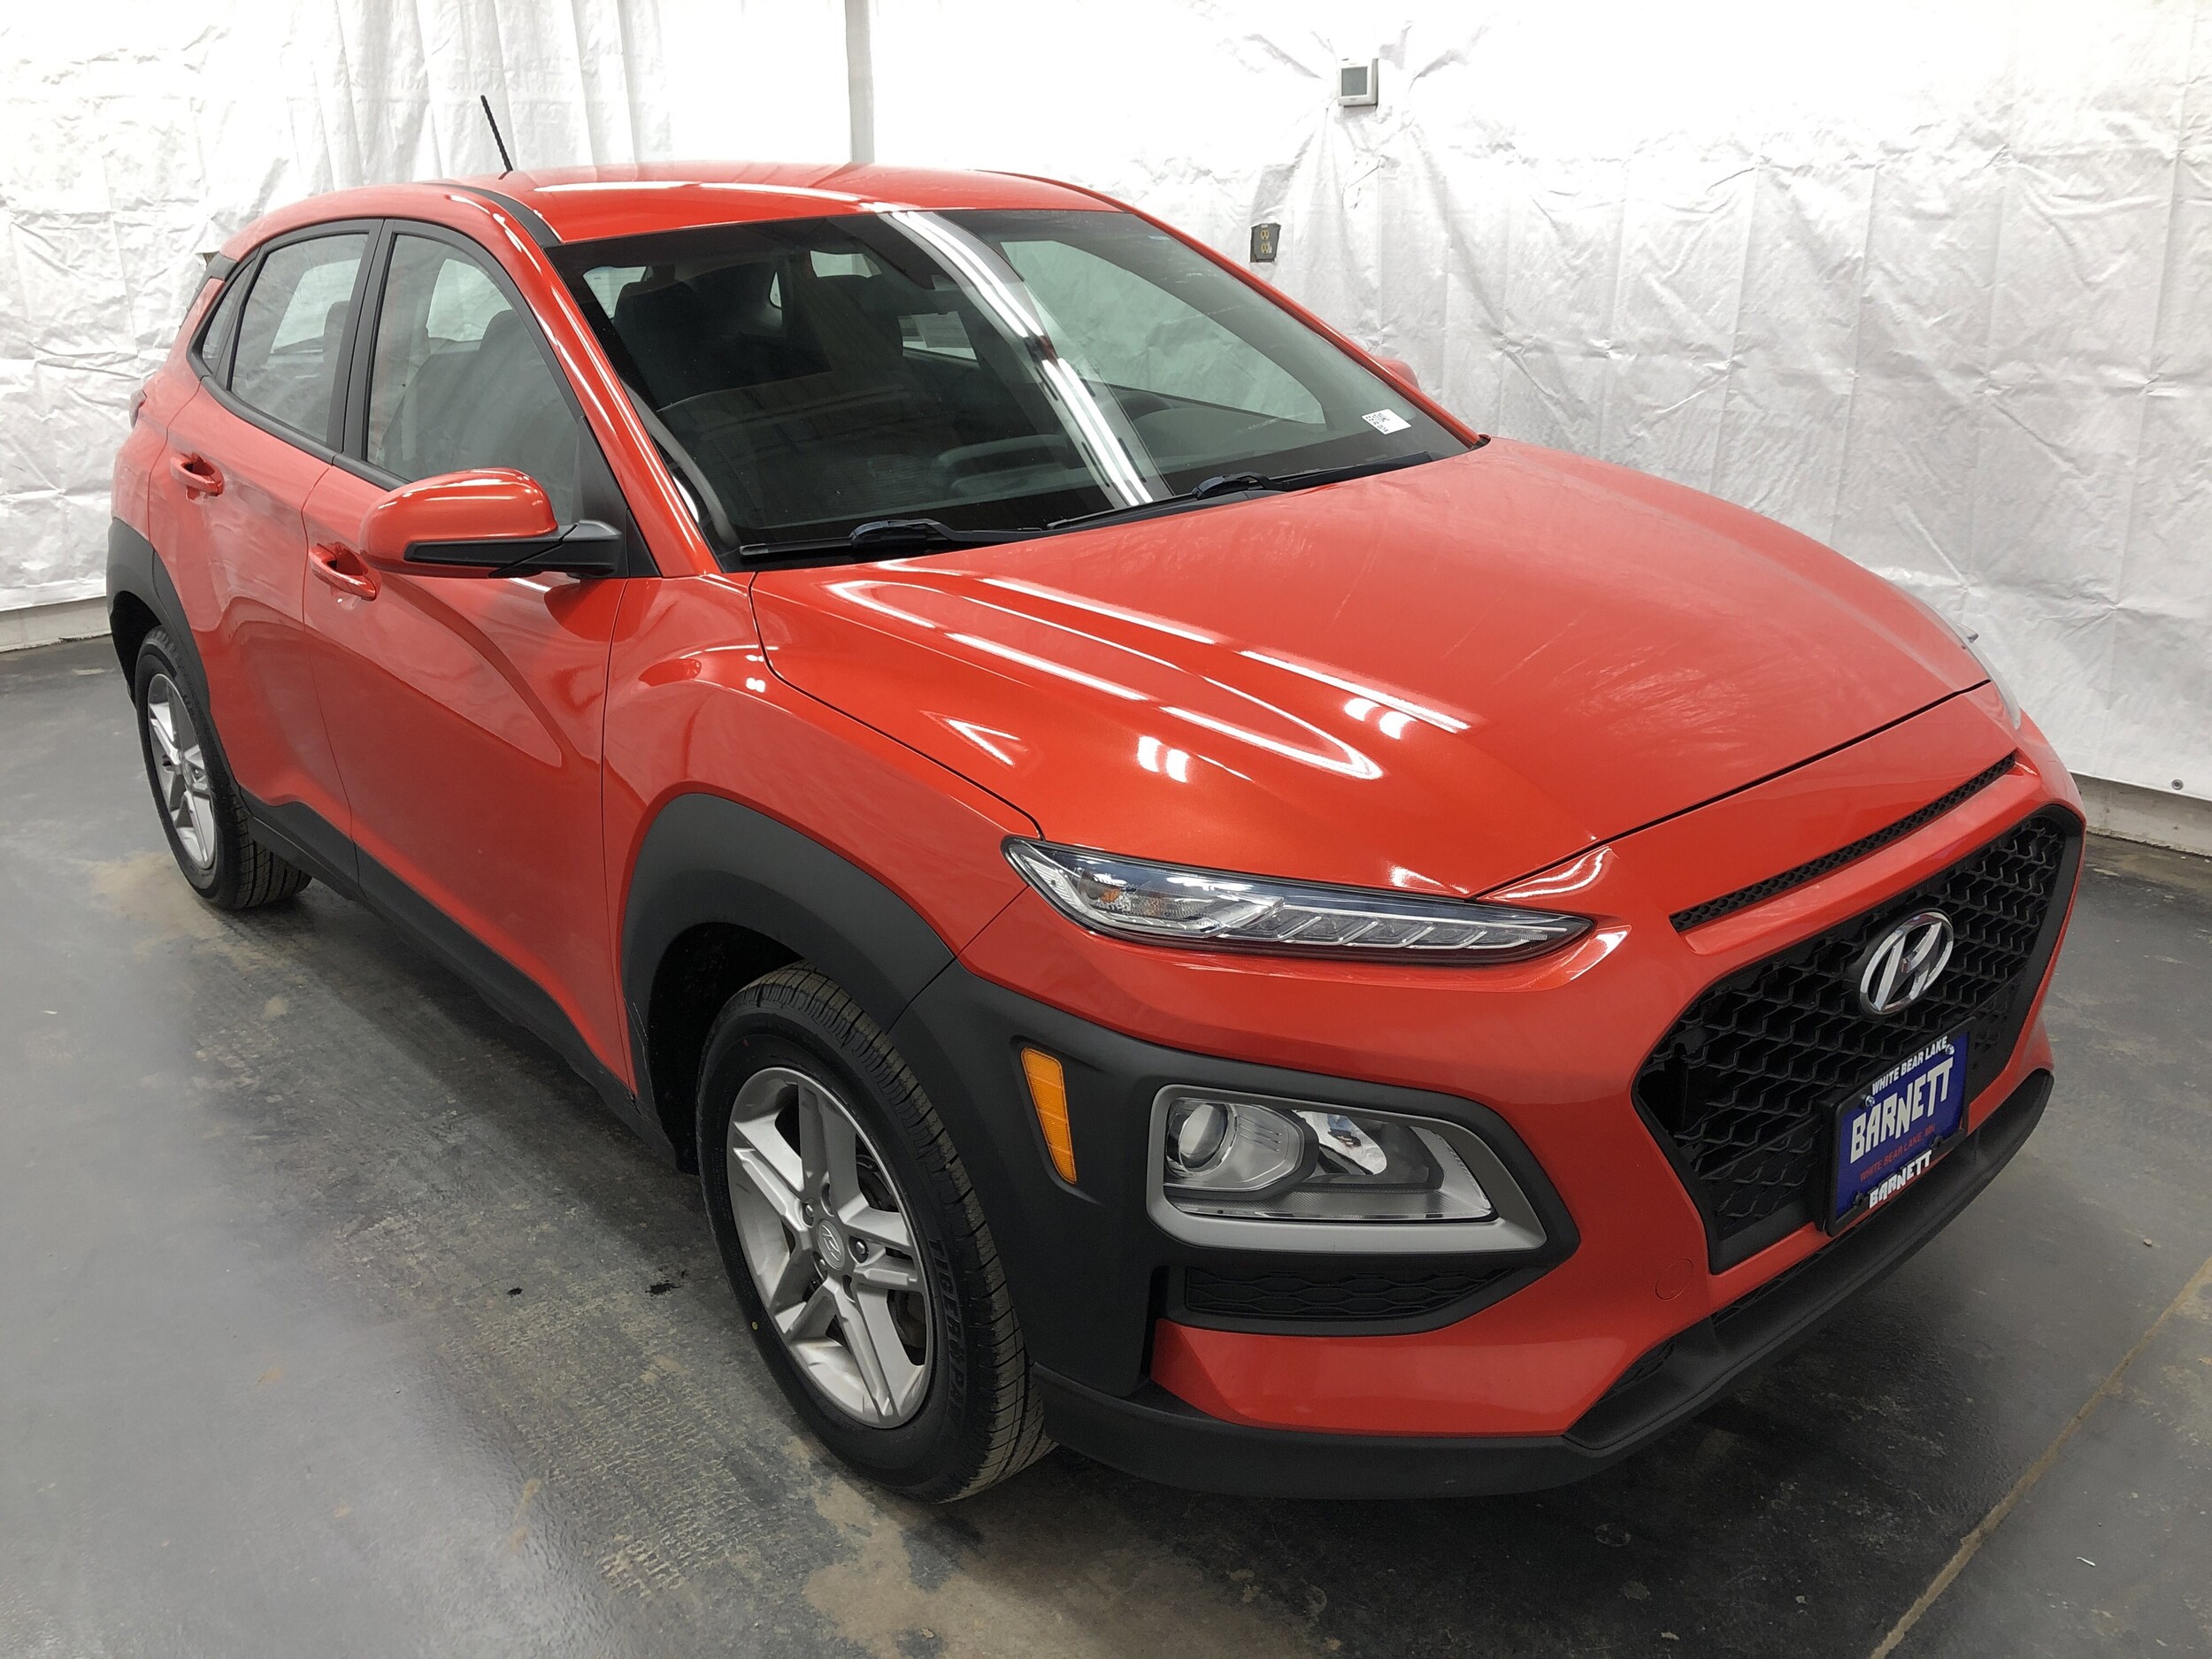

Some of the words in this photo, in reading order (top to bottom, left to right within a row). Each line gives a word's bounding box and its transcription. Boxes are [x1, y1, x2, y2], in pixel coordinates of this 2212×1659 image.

[1872, 1067, 1900, 1096] WHITE
[1901, 1051, 1924, 1077] BEAR
[1924, 1035, 1948, 1061] LAKE
[1850, 1056, 1954, 1164] BARNETT
[1869, 1148, 1932, 1209] BARNETT
[927, 1238, 962, 1341] TIGER
